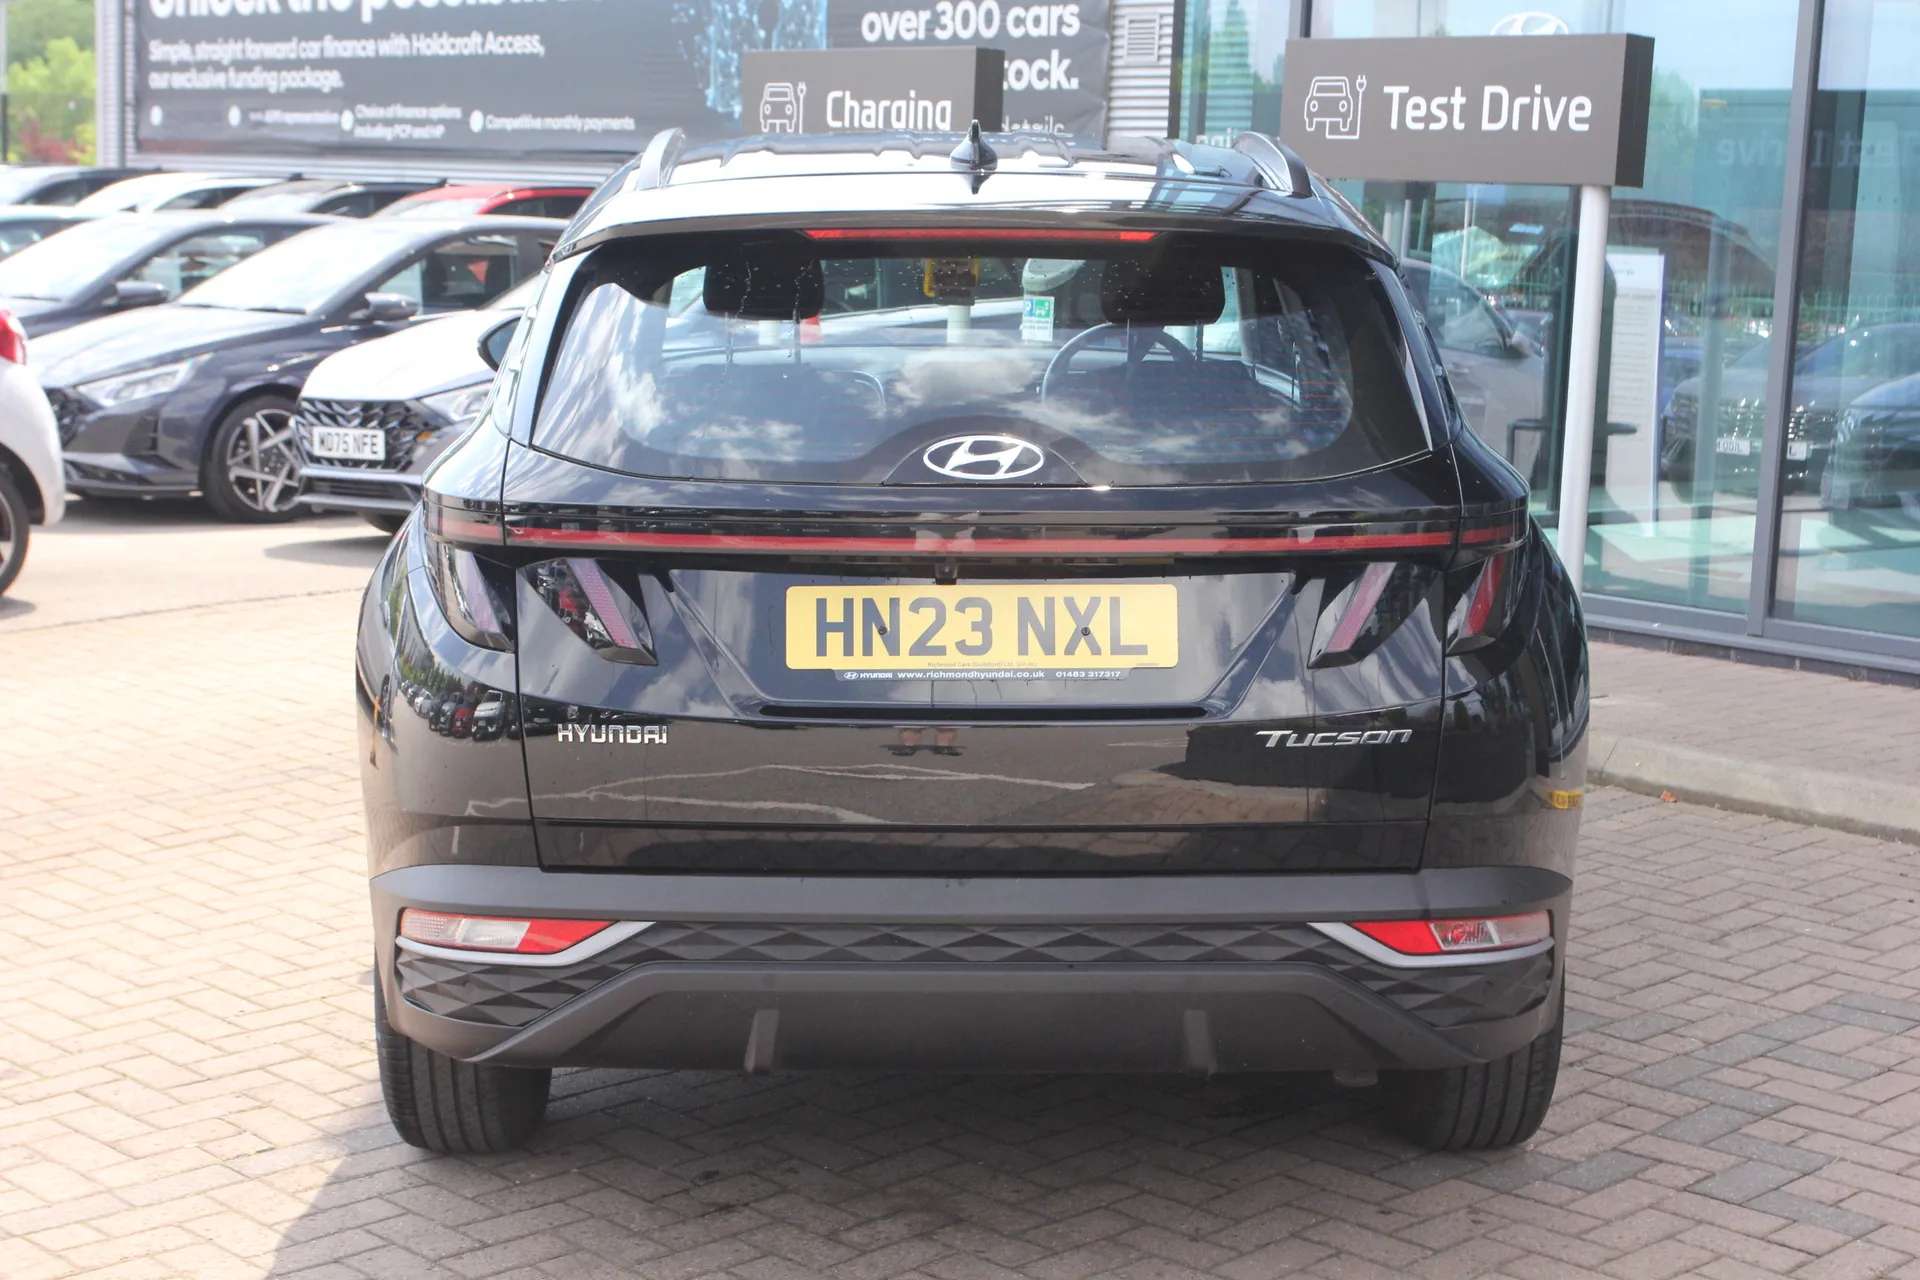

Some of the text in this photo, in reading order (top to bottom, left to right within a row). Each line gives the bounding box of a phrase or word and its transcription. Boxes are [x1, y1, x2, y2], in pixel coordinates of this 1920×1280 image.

[861, 0, 1080, 42] over 300 cars
[323, 35, 376, 58] finance
[377, 32, 410, 57] with
[411, 30, 483, 56] Holdcroft
[484, 30, 545, 58] Access,
[826, 89, 952, 131] Charging
[1383, 84, 1592, 131] Test Drive
[815, 596, 1149, 656] HN23 NXL
[860, 671, 893, 679] HYUNDAI
[897, 670, 1045, 679] www.richmondhyundai.co.uk
[557, 723, 668, 744] HYUNDAI
